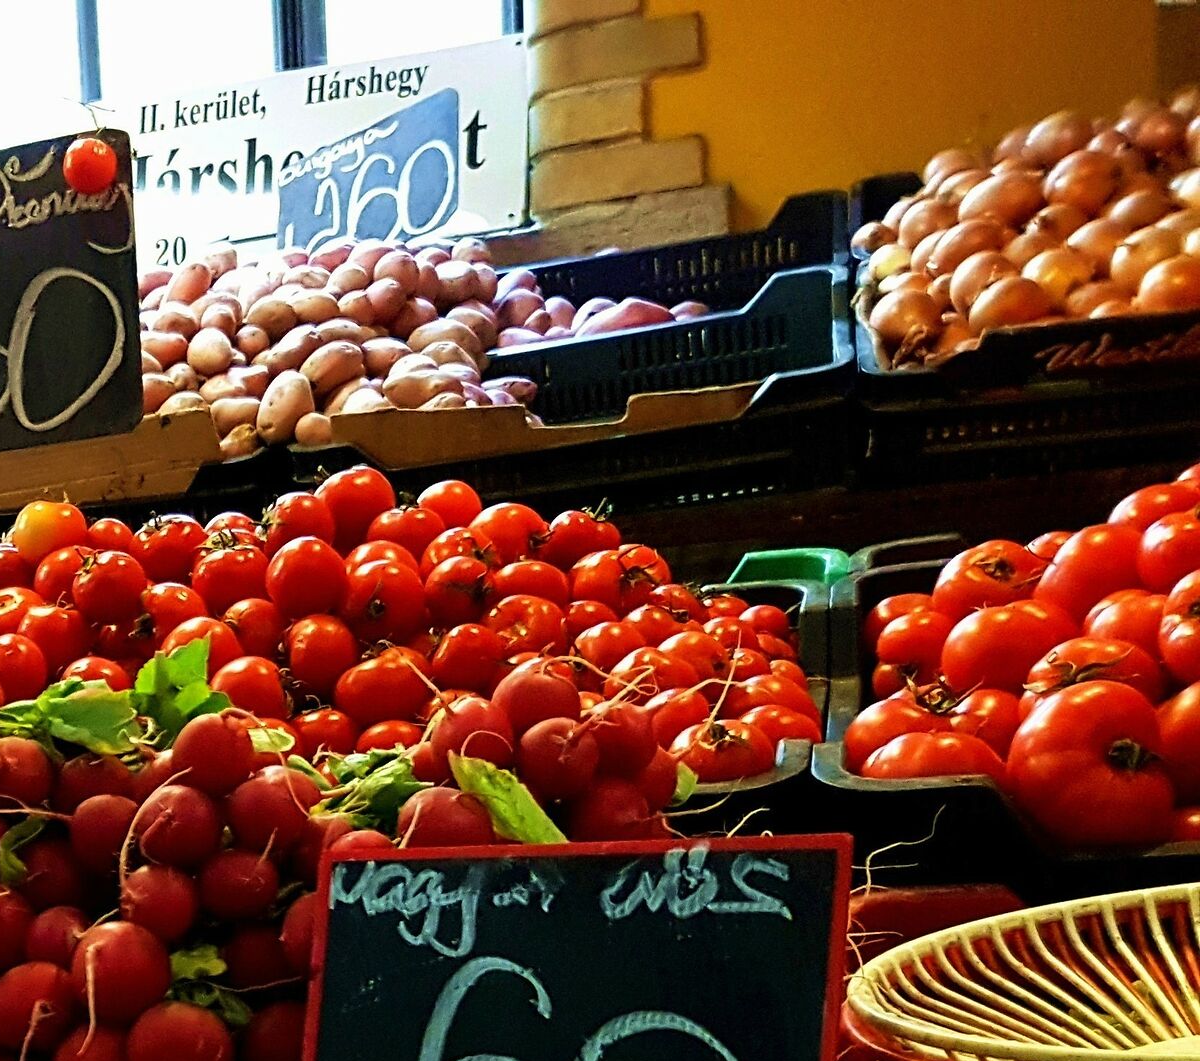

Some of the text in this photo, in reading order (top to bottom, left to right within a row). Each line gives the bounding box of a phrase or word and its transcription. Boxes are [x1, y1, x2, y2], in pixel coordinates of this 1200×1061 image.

[139, 63, 430, 134] II. kerület, Hárshegy
[155, 235, 187, 267] 20
